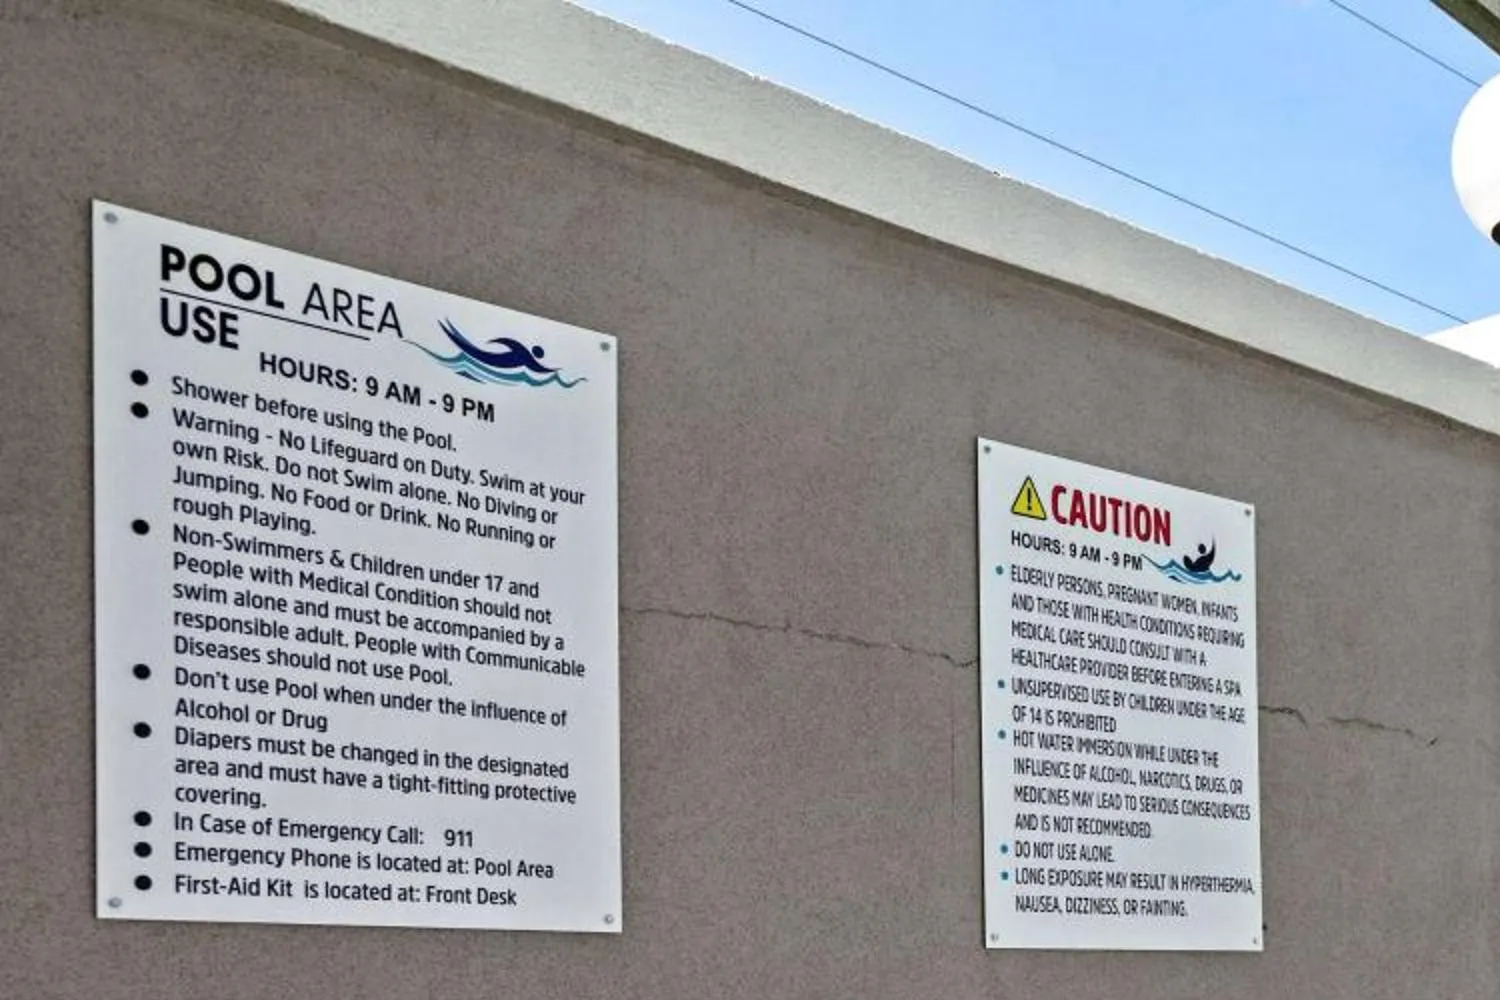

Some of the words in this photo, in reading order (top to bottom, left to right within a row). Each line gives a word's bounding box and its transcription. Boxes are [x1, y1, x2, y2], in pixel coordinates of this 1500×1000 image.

[159, 243, 285, 311] POOL
[301, 281, 404, 342] AREA
[159, 296, 240, 351] USE
[259, 351, 358, 393] HOURS:
[365, 375, 379, 397] 9
[384, 380, 422, 408] AM
[441, 392, 456, 414] 9
[461, 397, 495, 424] PM
[171, 375, 250, 409] Shower
[254, 392, 319, 424] before
[323, 410, 374, 438] using
[378, 419, 409, 443] the
[412, 425, 457, 453] Pool.
[171, 406, 260, 445] Warning
[279, 428, 306, 452] No
[310, 434, 399, 470] Lifeguard
[403, 456, 427, 475] on
[430, 458, 475, 486] Duty.
[479, 468, 525, 495] Swim
[528, 481, 546, 499] at
[549, 485, 587, 506] your
[172, 439, 218, 463] own
[223, 445, 270, 473] Risk.
[275, 455, 302, 478] Do
[307, 464, 340, 486] not
[343, 468, 394, 496] Swim
[397, 480, 453, 506] alone.
[456, 489, 481, 511] No
[484, 495, 537, 524] Diving
[540, 509, 559, 525] or
[173, 496, 234, 522] rough
[238, 503, 317, 537] Playing.
[1050, 484, 1172, 548] CAUTION
[173, 523, 325, 566] Non-Swimmers
[329, 548, 346, 569] &
[349, 551, 425, 581] Children
[428, 567, 481, 590] under
[483, 573, 505, 593] 17
[507, 580, 540, 600] and
[1010, 529, 1066, 557] HOURS:
[1068, 541, 1078, 559] 9
[1079, 544, 1101, 564] AM
[1110, 550, 1121, 568] 9
[1122, 552, 1144, 572] PM
[172, 551, 245, 581] People
[248, 565, 294, 588] with
[298, 569, 370, 599] Medical
[374, 581, 460, 612] Condition
[463, 596, 521, 621] should
[524, 607, 553, 625] not
[1010, 563, 1055, 589] ELDERLY
[1107, 582, 1160, 607] PREGNANT
[1201, 600, 1239, 623] INFANTS
[173, 610, 290, 641] responsible
[294, 625, 350, 649] adult.
[354, 630, 418, 657] People
[421, 641, 461, 663] with
[465, 645, 586, 679] Communicable
[173, 634, 261, 664] Diseases
[265, 647, 332, 673] should
[336, 658, 369, 677] not
[372, 662, 405, 681] use
[408, 663, 453, 687] Pool.
[1011, 619, 1057, 645] MEDICAL
[1058, 627, 1086, 649] CARE
[1087, 631, 1127, 655] SHOULD
[1129, 638, 1172, 662] CONSULT
[1171, 646, 1198, 666] WITH
[1198, 651, 1208, 668] A
[174, 697, 250, 724] Alcohol
[255, 709, 277, 726] or
[281, 707, 329, 734] Drug
[1011, 676, 1090, 704] UNSUPERVISED
[1090, 687, 1111, 707] USE
[1112, 690, 1127, 709] BY
[1127, 692, 1175, 715] CHILDREN
[1175, 699, 1208, 719] UNDER
[1208, 702, 1227, 722] THE
[1227, 706, 1246, 725] AGE
[1011, 704, 1028, 724] OF
[1029, 706, 1043, 725] 14
[1044, 708, 1055, 727] IS
[174, 786, 268, 811] covering.
[1013, 784, 1071, 807] MEDICINES
[1071, 789, 1095, 808] MAY
[1096, 791, 1123, 811] LEAD
[1123, 793, 1138, 813] TO
[1139, 795, 1180, 816] SERIOUS
[1180, 798, 1251, 821] CONSEQUENCES
[1014, 812, 1039, 831] AND
[1040, 814, 1051, 833] IS
[1052, 815, 1075, 834] NOT
[173, 811, 194, 832] In
[199, 813, 247, 835] Case
[251, 817, 273, 837] of
[277, 817, 382, 846] Emergency
[386, 825, 425, 846] Call:
[443, 828, 474, 849] 911
[1014, 839, 1031, 860] DO
[1032, 841, 1055, 860] NOT
[1056, 842, 1077, 862] USE
[174, 873, 261, 897] First-Aid
[266, 877, 294, 898] Kit
[303, 879, 320, 899] is
[324, 880, 393, 902] located
[396, 884, 421, 903] at:
[425, 884, 473, 905] Front
[476, 887, 518, 907] Desk
[1122, 898, 1139, 916] OR
